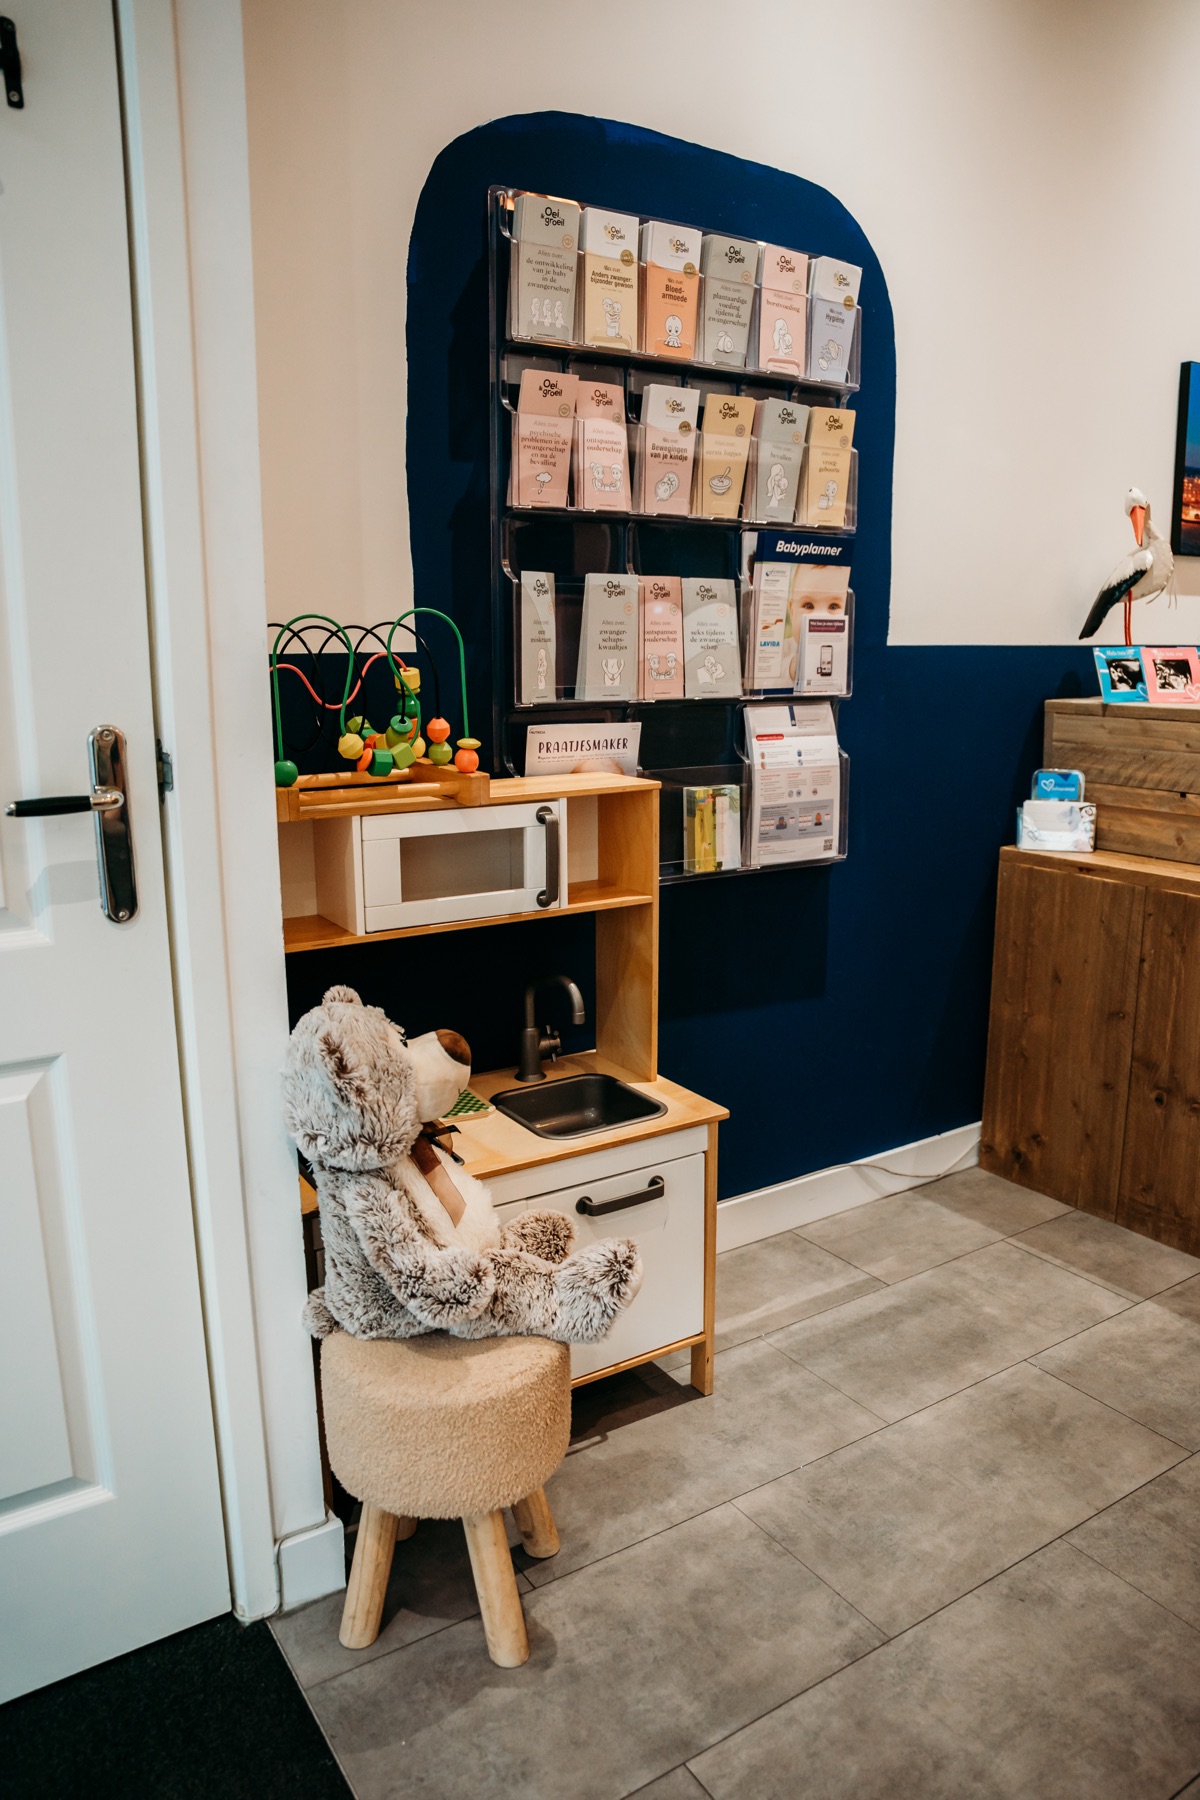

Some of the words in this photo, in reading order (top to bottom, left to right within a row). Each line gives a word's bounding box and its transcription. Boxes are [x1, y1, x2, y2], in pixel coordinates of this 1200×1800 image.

[535, 259, 574, 271] ontwikkeling
[545, 268, 552, 276] je
[553, 269, 567, 278] baby
[592, 270, 609, 279] Anders
[591, 276, 613, 285] bijzonder
[614, 281, 634, 289] gewoon
[527, 282, 571, 294] zwangerschap
[665, 284, 685, 293] Bloed-
[661, 292, 688, 303] armoede
[712, 293, 748, 305] plantaardige
[718, 302, 741, 311] voeding
[766, 299, 800, 313] borstvoeding
[715, 308, 734, 318] tijdens
[707, 316, 748, 328] zwangerschap
[529, 430, 562, 438] psychische
[521, 436, 553, 445] problemen
[586, 438, 622, 446] ontspannen
[522, 444, 566, 454] zwangerschap
[586, 444, 622, 454] ouderschap
[651, 443, 688, 454] Bewegingen
[662, 452, 668, 460] je
[669, 453, 688, 462] kindje
[530, 458, 557, 467] bevalling
[775, 540, 843, 556] Babyplanner
[706, 629, 726, 637] tijdens
[598, 643, 628, 651] kwaaltjes
[701, 643, 718, 651] schap
[538, 737, 629, 754] PRAATJESMAKER
